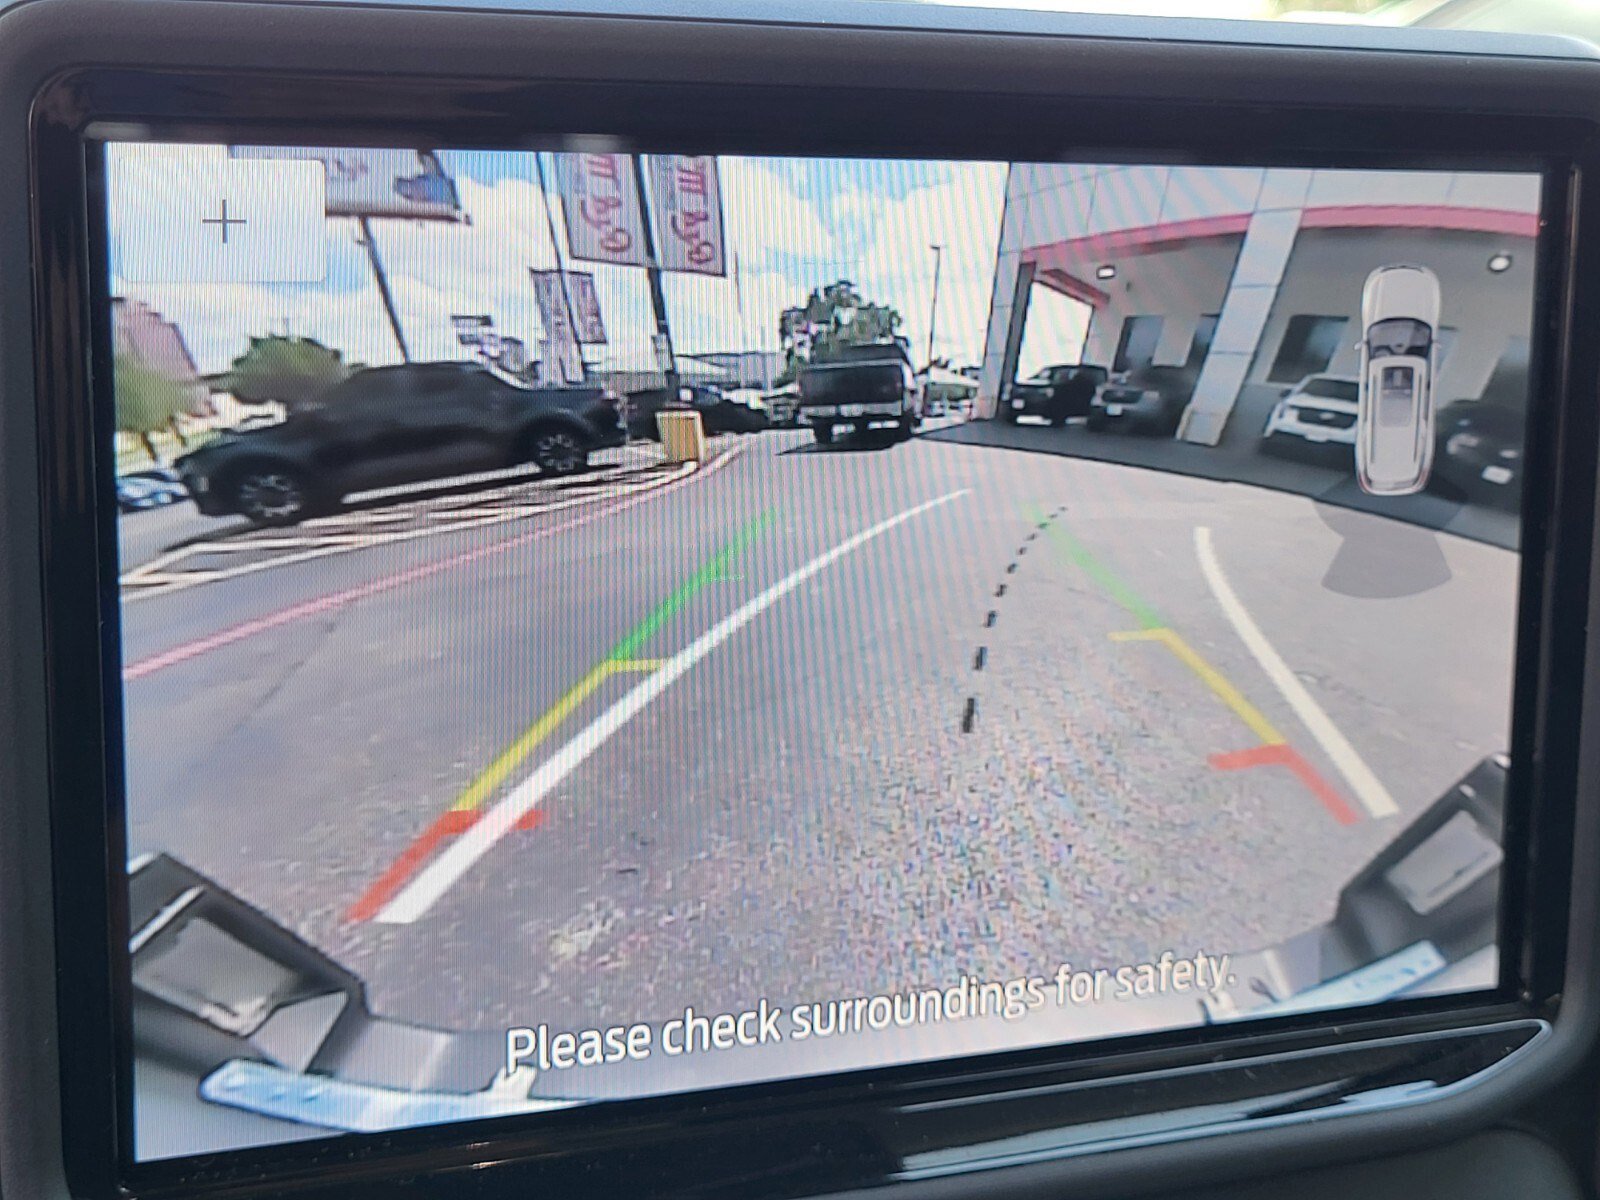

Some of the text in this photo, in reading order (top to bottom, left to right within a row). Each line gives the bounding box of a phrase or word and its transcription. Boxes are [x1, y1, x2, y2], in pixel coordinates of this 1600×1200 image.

[506, 951, 1237, 1073] Please check surroundings for safety.
